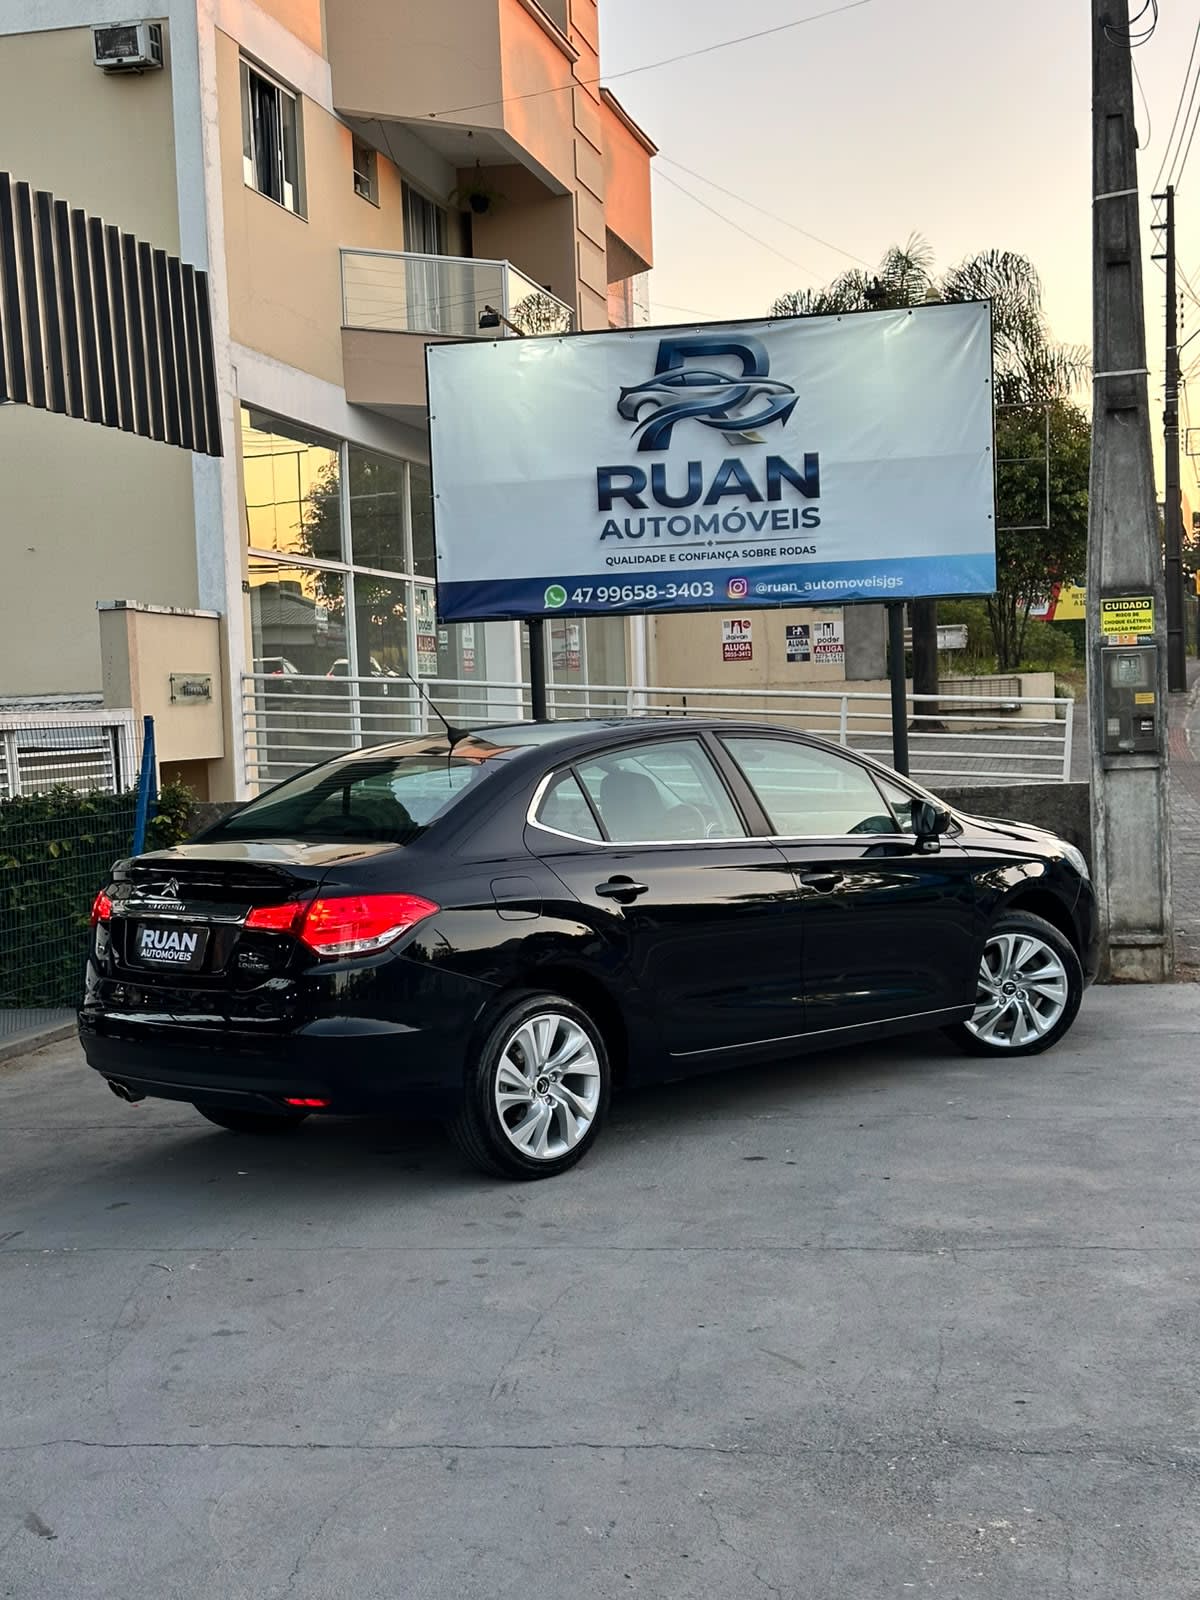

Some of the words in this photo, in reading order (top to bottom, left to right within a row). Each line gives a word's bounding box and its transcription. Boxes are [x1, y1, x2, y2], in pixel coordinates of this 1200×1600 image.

[596, 452, 821, 512] RUAN
[599, 506, 821, 541] AUTOMÓVEIS
[605, 554, 667, 567] QUALIDADE
[669, 553, 676, 562] E
[678, 549, 740, 563] CONFIANÇA
[742, 547, 778, 559] SOBRE
[779, 545, 817, 556] RODAS
[572, 588, 594, 604] 47
[596, 580, 715, 602] 99658-3403
[755, 575, 904, 595] @ruan_automoveisjgs
[1105, 601, 1150, 610] CUIDADO
[724, 643, 752, 651] ALUGA
[788, 640, 809, 648] ALUGA
[815, 645, 843, 653] ALUGA
[141, 929, 198, 952] RUAN
[140, 948, 192, 961] AUTOMÓVEIS
